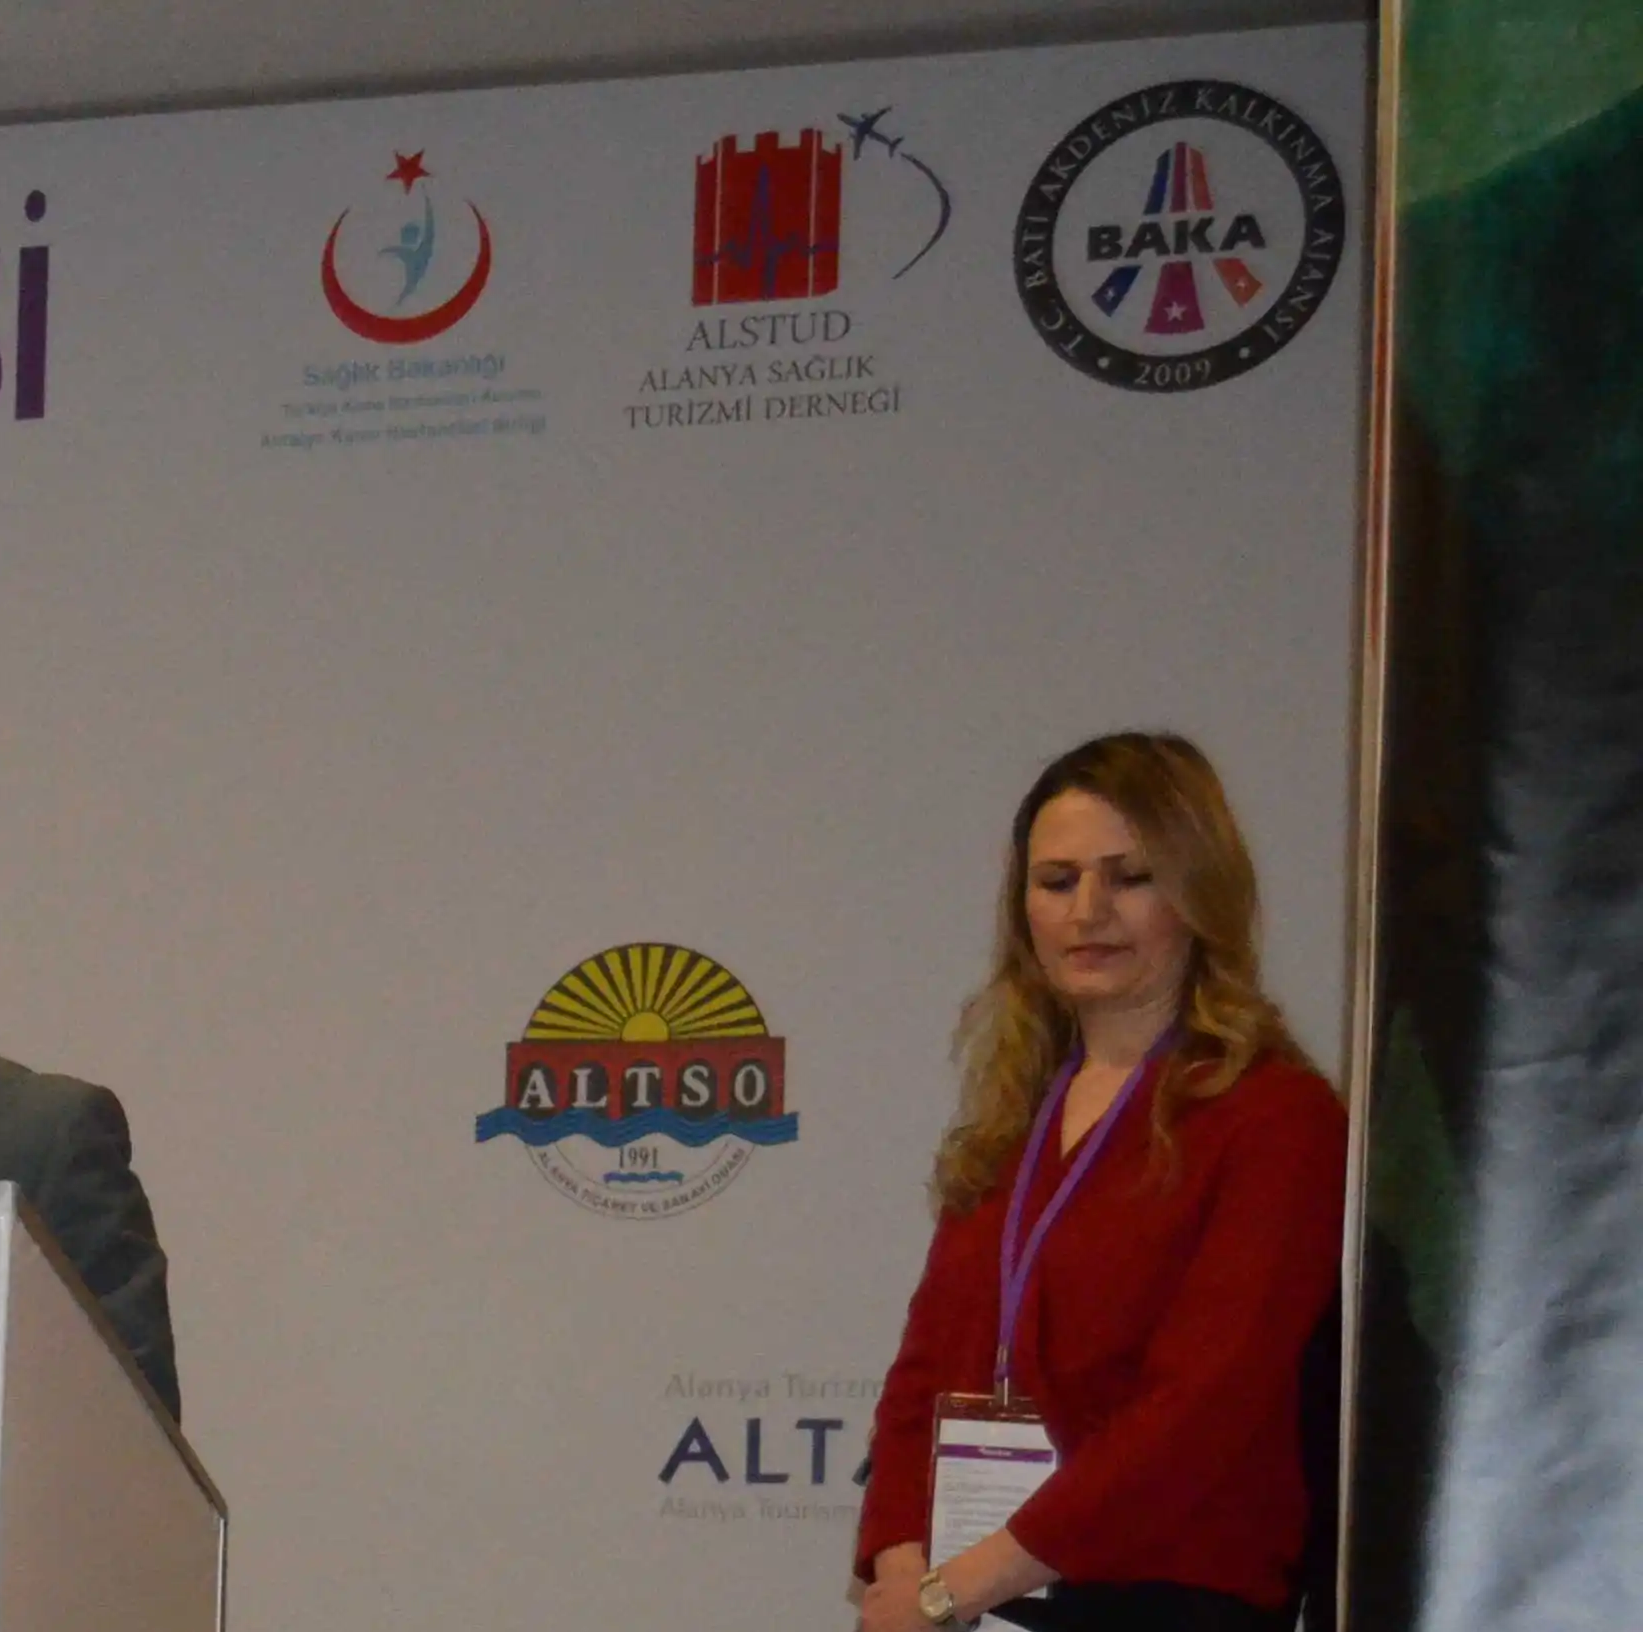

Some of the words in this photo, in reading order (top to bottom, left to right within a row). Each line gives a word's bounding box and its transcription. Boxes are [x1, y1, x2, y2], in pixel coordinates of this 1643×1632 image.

[1023, 215, 1050, 289] BATI
[1041, 90, 1177, 202] AKDENİZ
[1193, 86, 1335, 212] KALKINMA
[1086, 213, 1267, 262] BAKA
[685, 309, 853, 352] ALSTUD
[638, 361, 758, 393] ALANYA
[766, 354, 877, 385] SAĞLIK
[1133, 358, 1212, 387] 2009
[623, 394, 752, 430] TURİZMİ
[517, 1065, 767, 1110] ALTSO
[618, 1146, 659, 1170] 1991
[664, 1373, 771, 1402] Alanya
[658, 1416, 873, 1487] ALT
